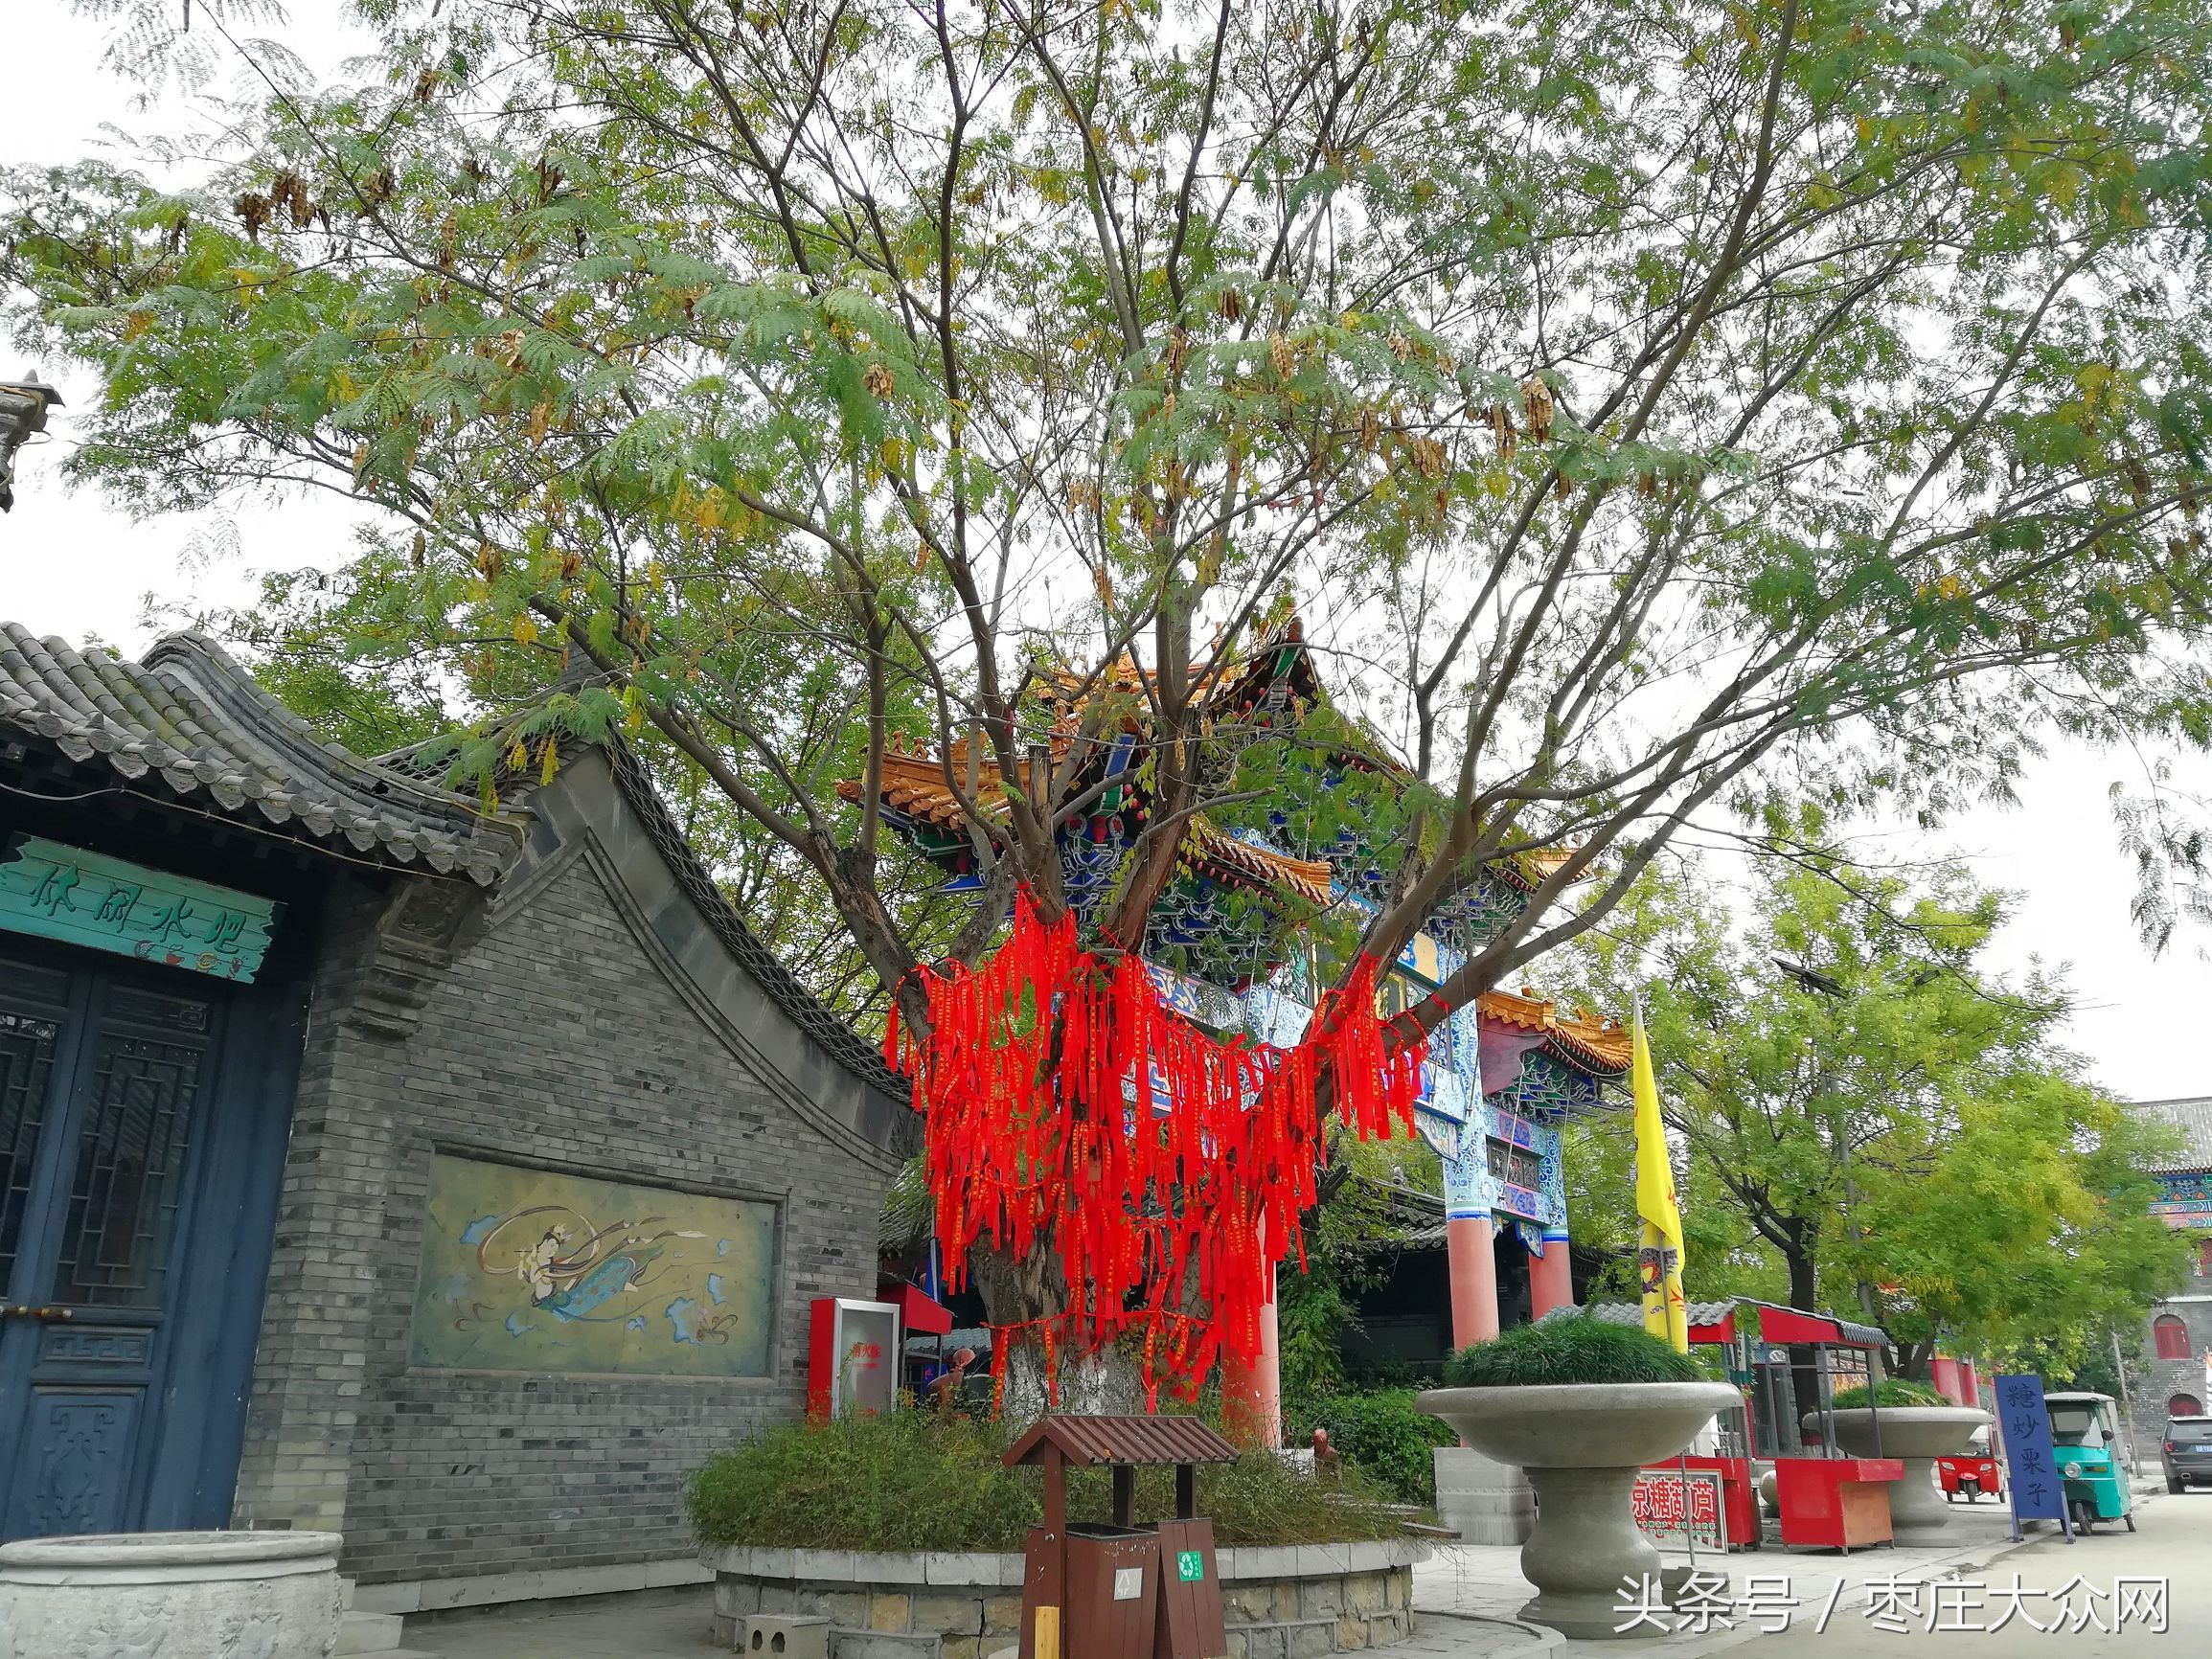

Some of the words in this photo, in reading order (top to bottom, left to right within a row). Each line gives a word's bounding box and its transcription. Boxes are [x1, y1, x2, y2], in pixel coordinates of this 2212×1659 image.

[30, 864, 247, 954] 休闲水吧
[2006, 1382, 2048, 1508] 糖炒栗子
